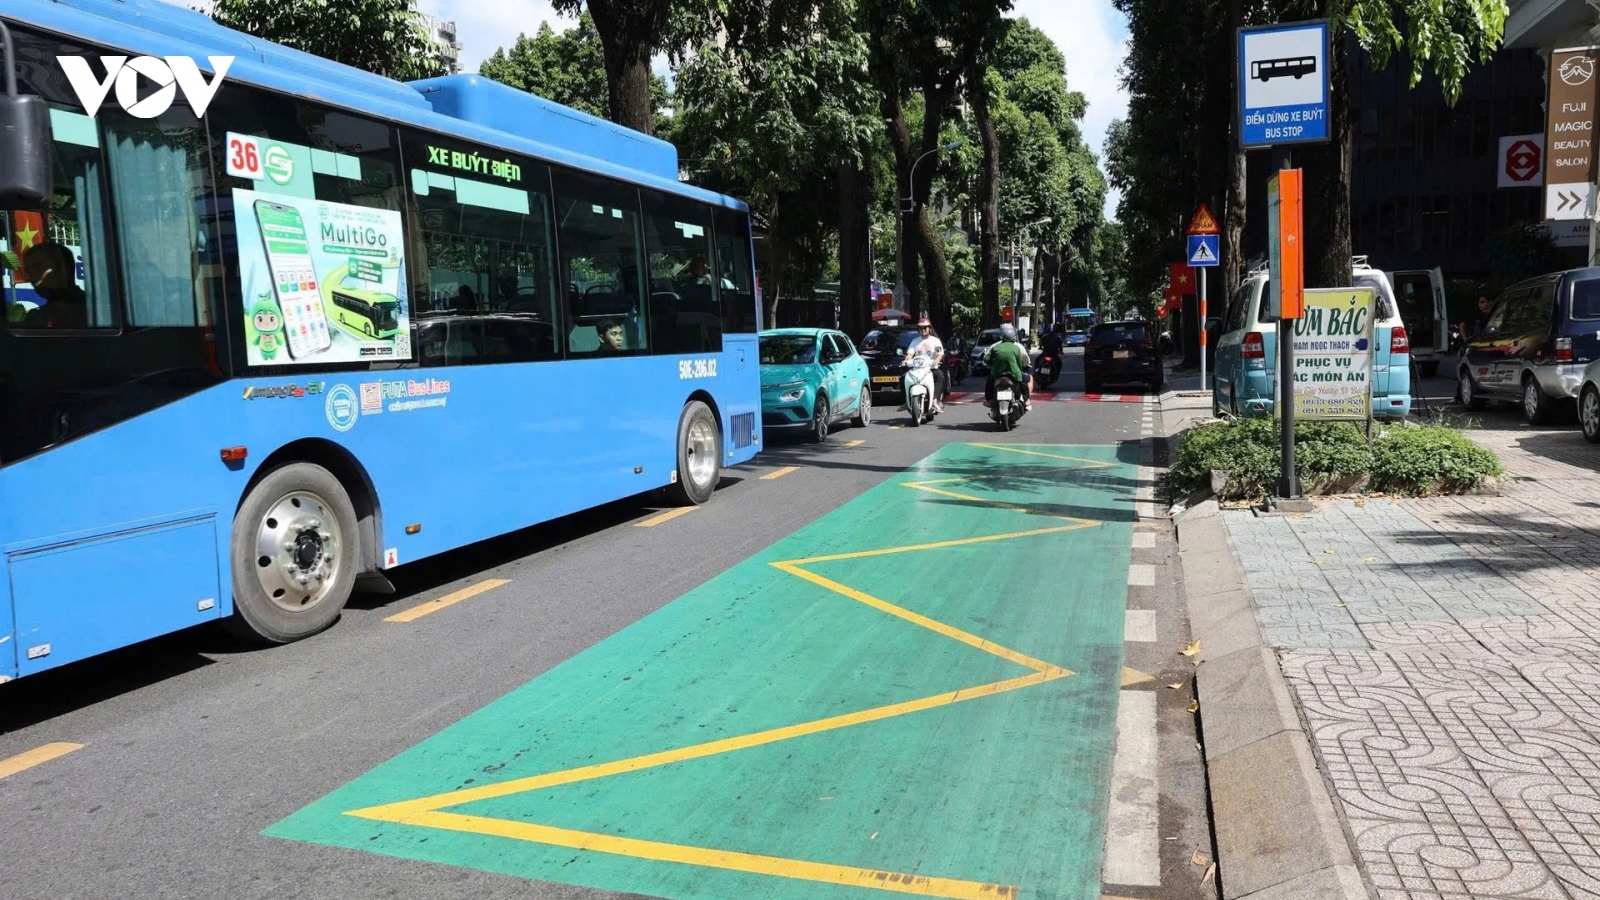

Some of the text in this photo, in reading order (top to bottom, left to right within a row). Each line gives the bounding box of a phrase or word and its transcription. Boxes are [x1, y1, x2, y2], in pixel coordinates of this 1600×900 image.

[1562, 102, 1587, 113] FUJI
[1246, 107, 1323, 125] ĐIỂM DỪNG XE BUÝT
[1265, 126, 1303, 138] BUS STOP
[1554, 120, 1593, 133] MAGIC
[1554, 139, 1591, 150] BEAUTY
[230, 139, 259, 173] 36
[1555, 157, 1588, 167] SALON
[428, 145, 521, 182] XE BUÝT ĐIỆN
[320, 222, 387, 247] MultiGo
[1295, 295, 1367, 336] ƠM BẮC
[1293, 341, 1309, 352] HẠM
[1310, 341, 1328, 351] NGỌC
[1296, 357, 1352, 369] PHỤC VỤ
[1293, 371, 1365, 382] ÁC MÓN ĂN
[381, 381, 407, 399] FUTA
